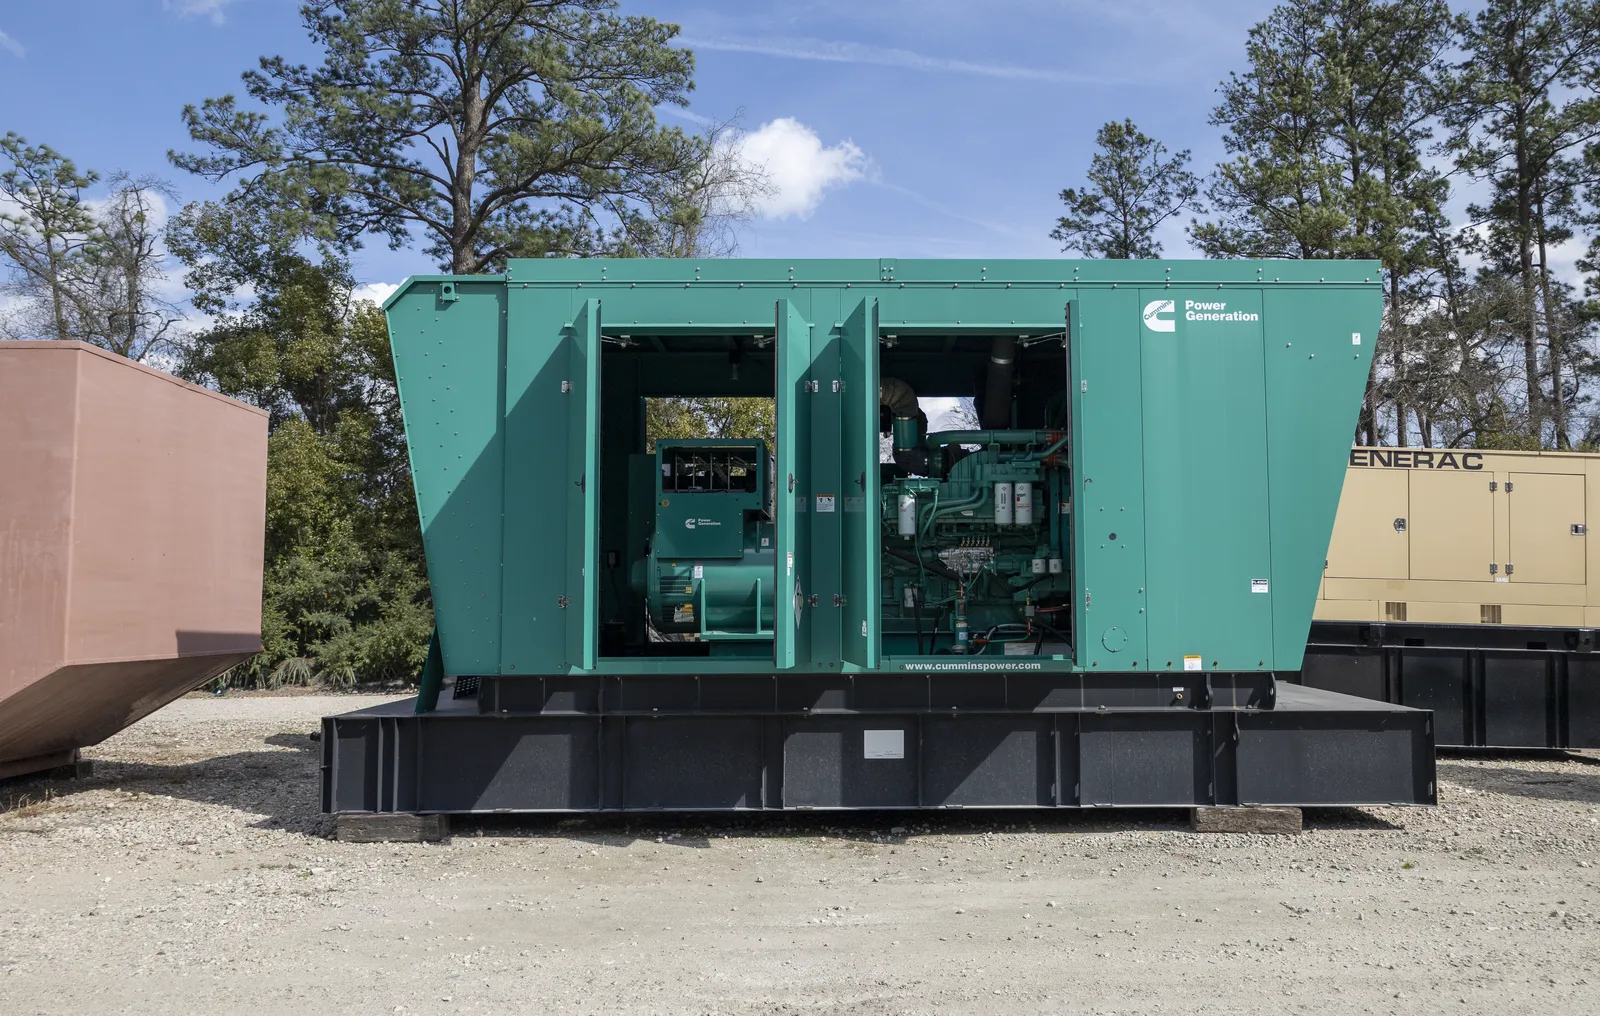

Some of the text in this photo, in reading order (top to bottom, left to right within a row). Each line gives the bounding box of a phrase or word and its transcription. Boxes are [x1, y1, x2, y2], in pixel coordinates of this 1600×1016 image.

[1143, 300, 1172, 320] Cummins
[1185, 300, 1226, 310] Power
[1185, 311, 1259, 321] Generation
[1350, 449, 1483, 470] ENERAC
[905, 661, 1041, 671] www.cumminspower.com
